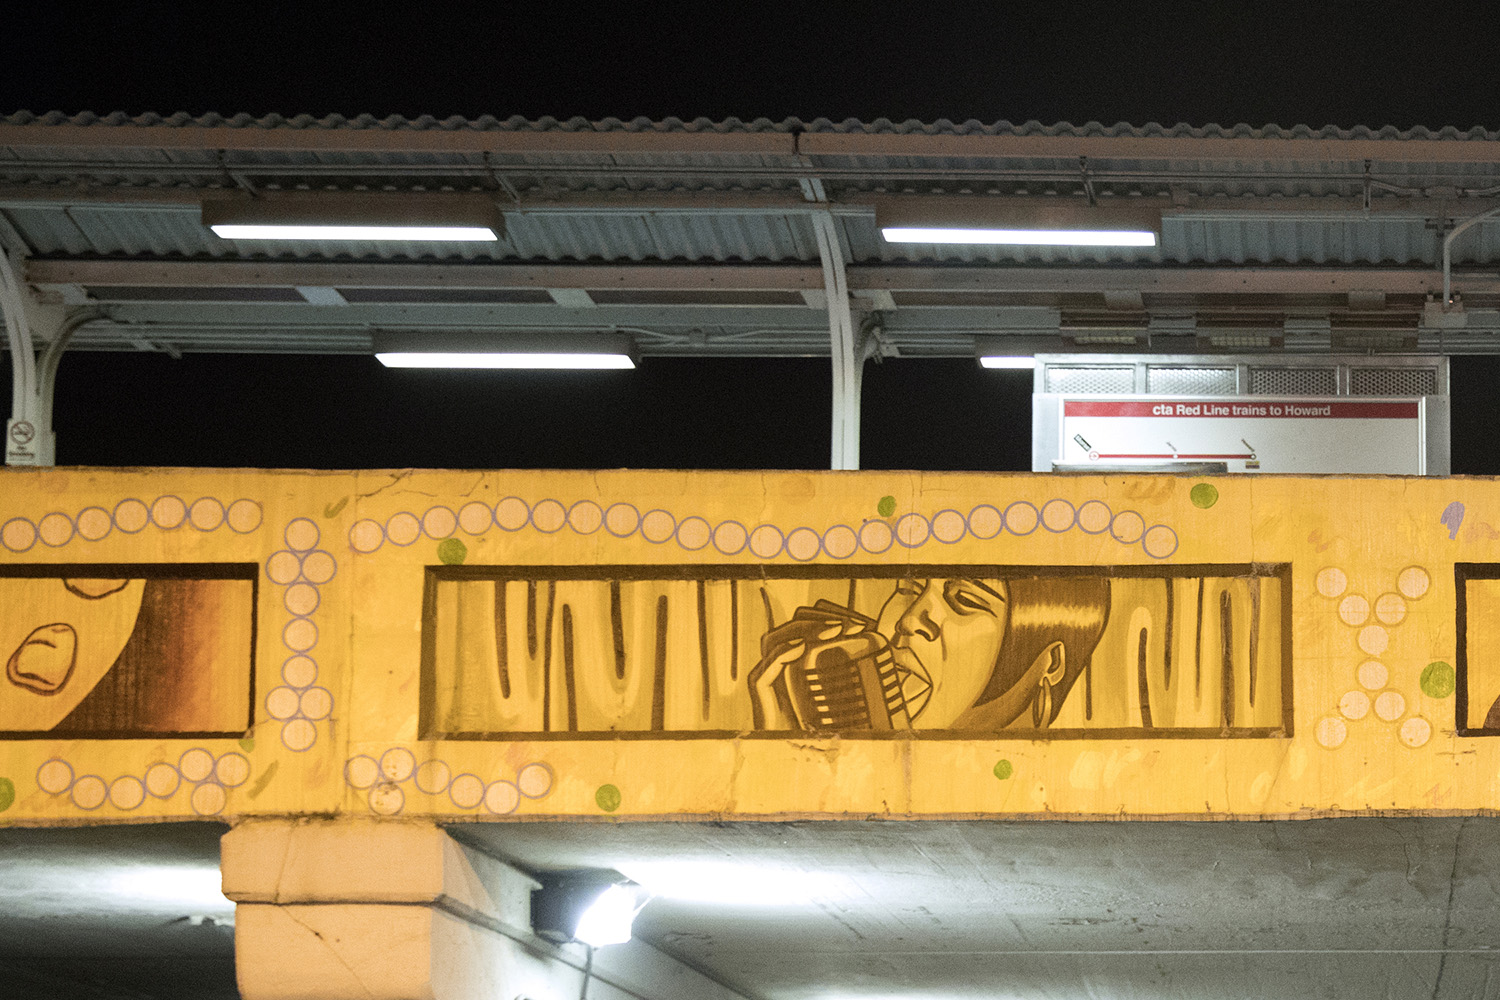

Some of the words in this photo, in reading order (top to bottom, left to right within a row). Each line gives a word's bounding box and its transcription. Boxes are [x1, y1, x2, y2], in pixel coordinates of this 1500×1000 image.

[1152, 404, 1173, 416] cta
[1176, 404, 1201, 416] Red
[1203, 404, 1230, 416] Line
[1232, 404, 1267, 416] trains
[1269, 405, 1282, 416] to
[1285, 405, 1331, 416] Howard
